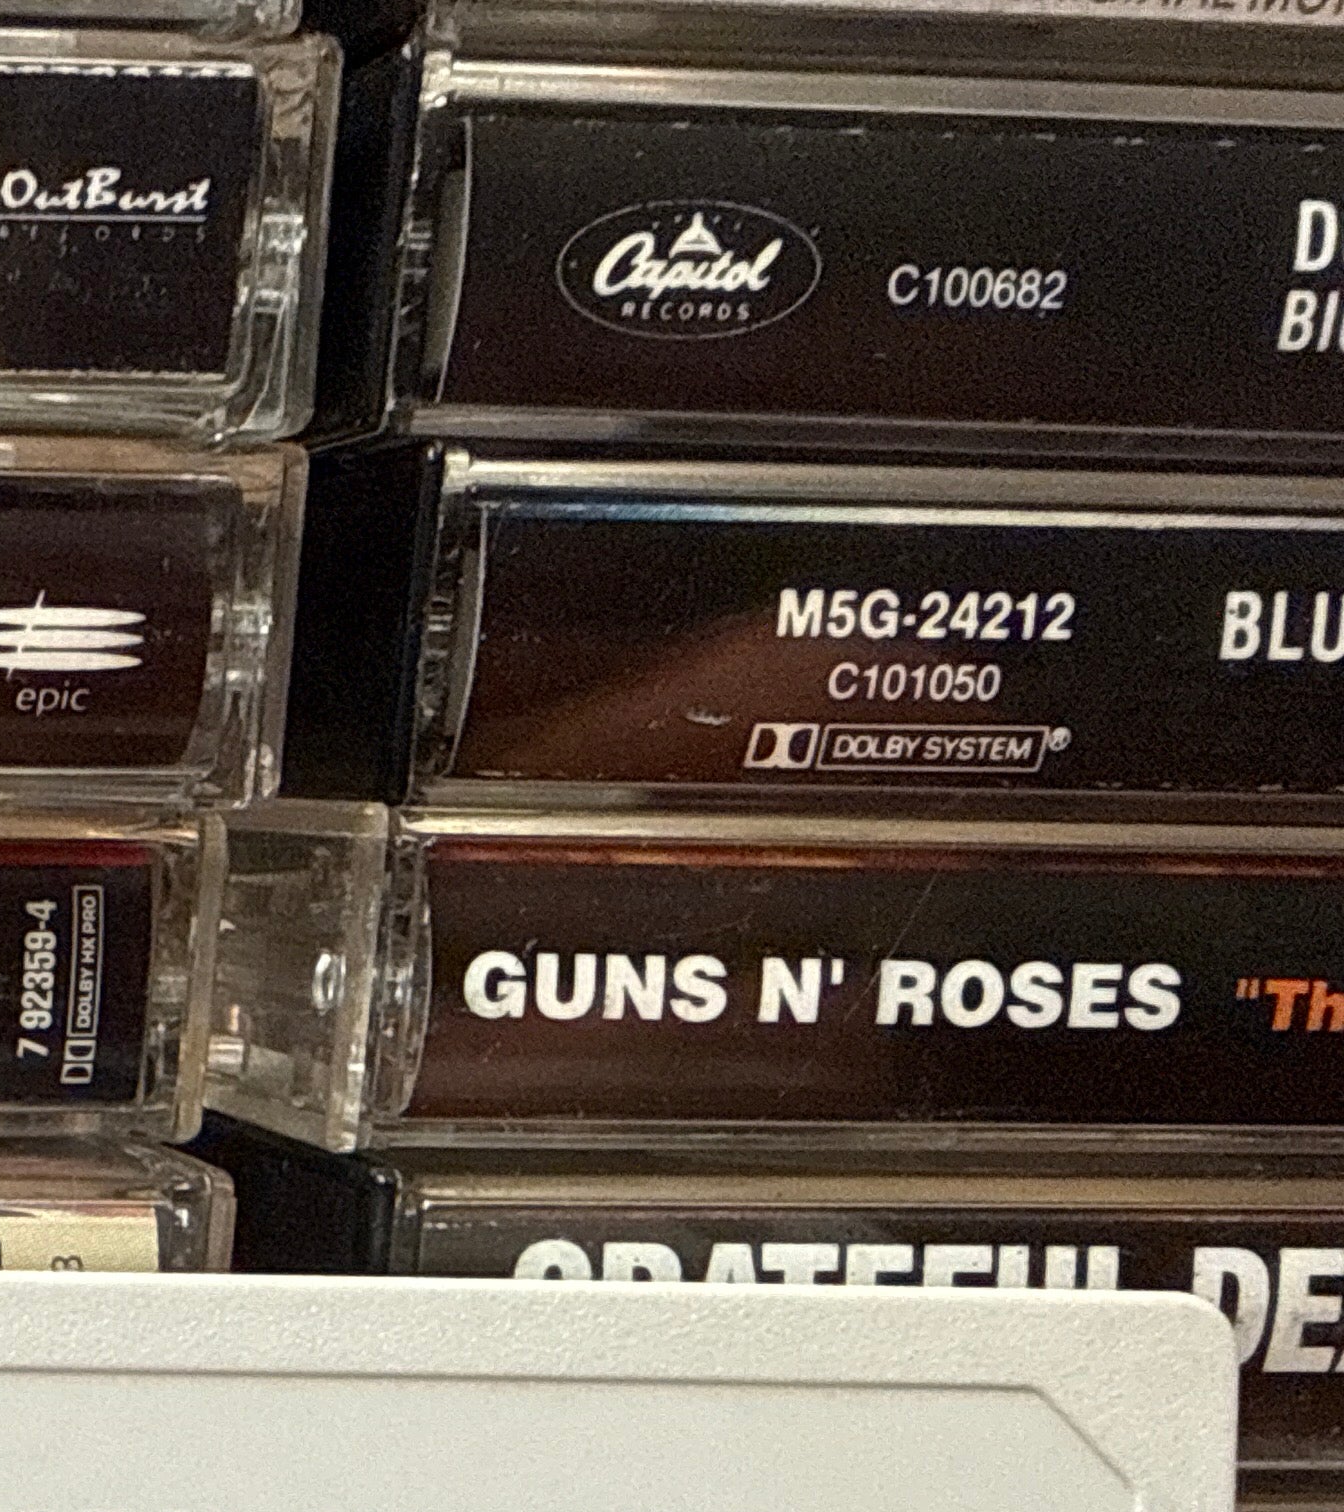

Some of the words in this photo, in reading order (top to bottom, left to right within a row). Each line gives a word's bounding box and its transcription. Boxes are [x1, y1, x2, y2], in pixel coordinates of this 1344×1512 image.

[1293, 199, 1344, 272] D
[592, 230, 784, 300] Capitol
[887, 264, 1067, 310] C100682
[620, 300, 752, 321] RECORDS
[1278, 289, 1344, 352] BI
[776, 588, 1075, 640] M5G-24212
[15, 680, 90, 717] epic
[827, 661, 1001, 702] C101050
[832, 734, 920, 759] DOLBY
[923, 736, 1033, 760] SYSTEM
[81, 895, 97, 935] PRO
[20, 899, 58, 1030] 92359-4
[81, 937, 97, 964] HX
[76, 967, 95, 1029] DOLBY
[463, 950, 727, 1023] GUNS
[758, 957, 844, 1023] N'
[875, 959, 1181, 1030] ROSES
[16, 1036, 50, 1058] 7
[1193, 1246, 1344, 1373] DE
